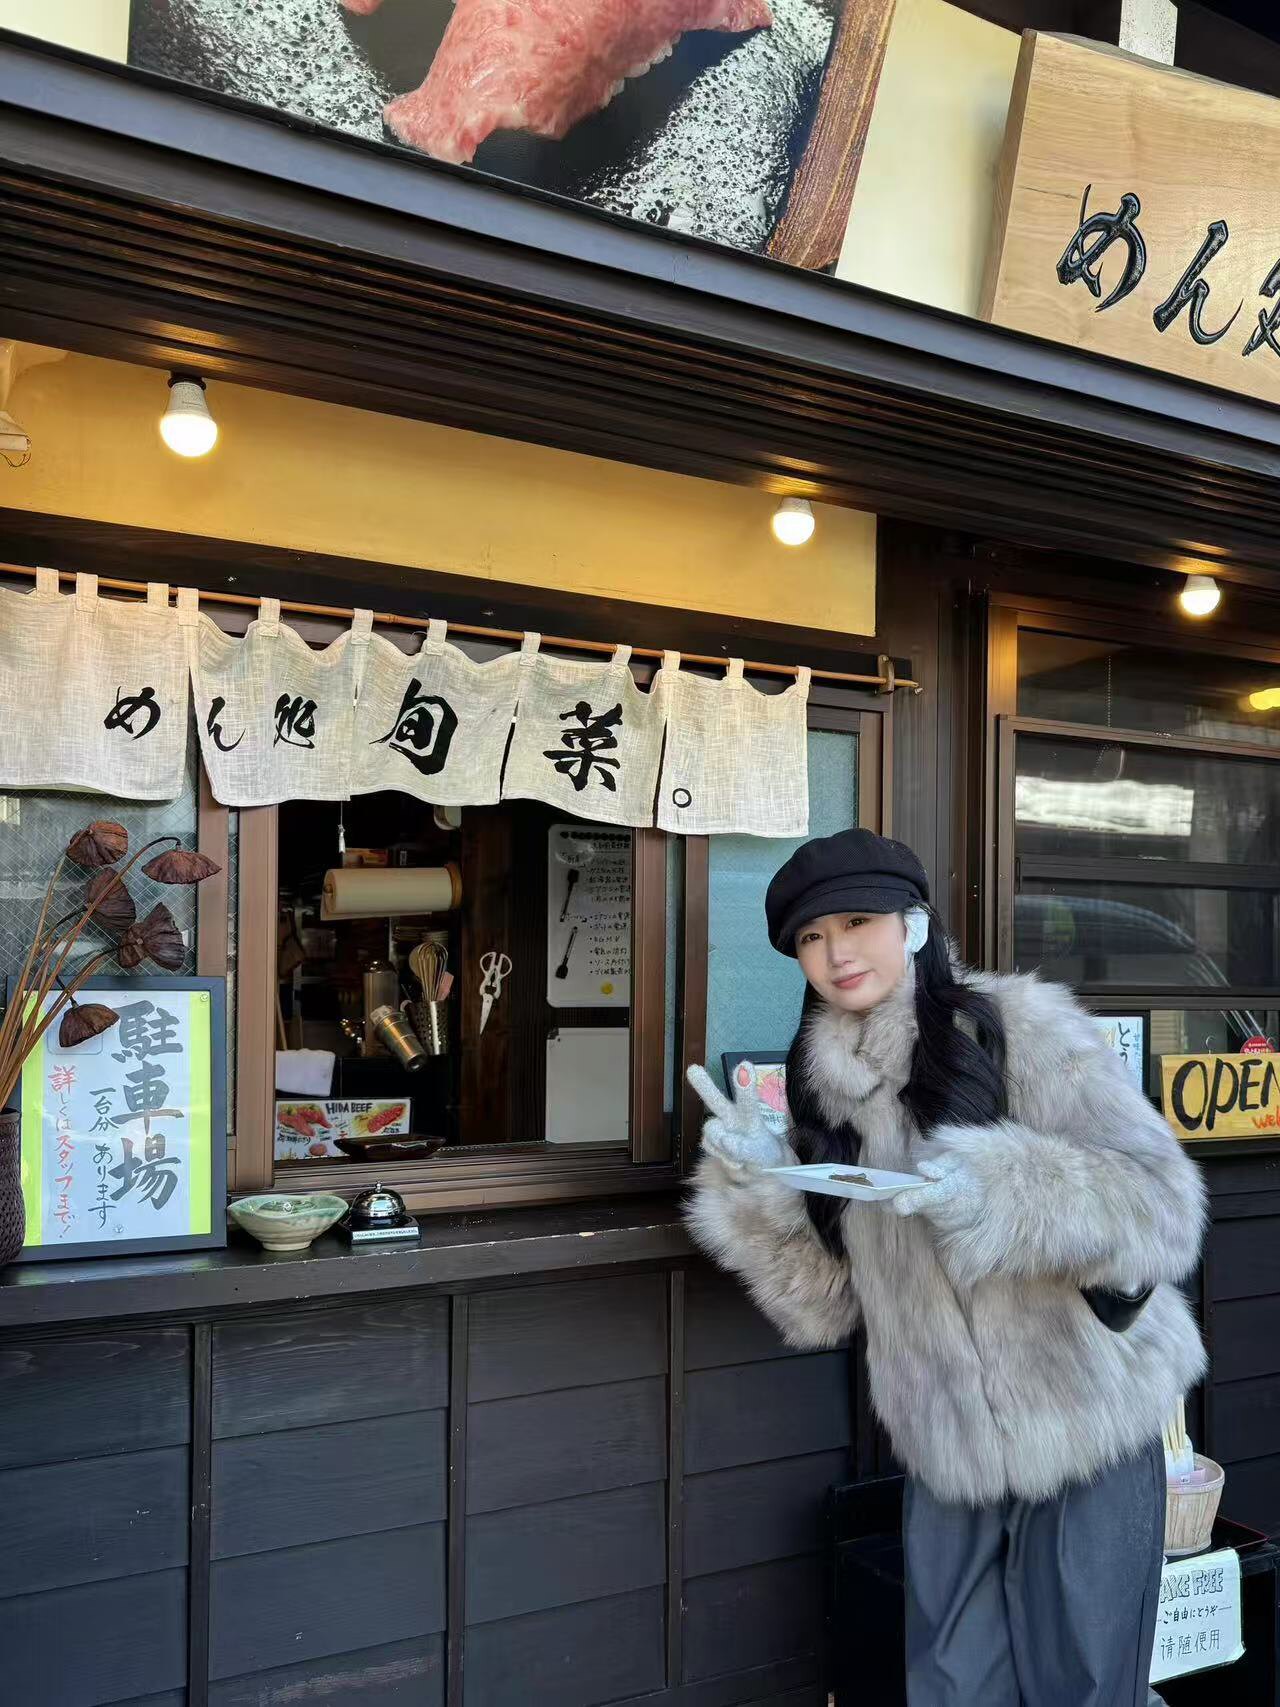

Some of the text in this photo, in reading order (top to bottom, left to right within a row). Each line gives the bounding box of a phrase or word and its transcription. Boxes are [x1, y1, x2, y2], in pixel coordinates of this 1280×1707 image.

[110, 1000, 184, 1210] 駐車場
[325, 1102, 373, 1114] HIDA BEEF
[1160, 1568, 1223, 1603] AKE FREE
